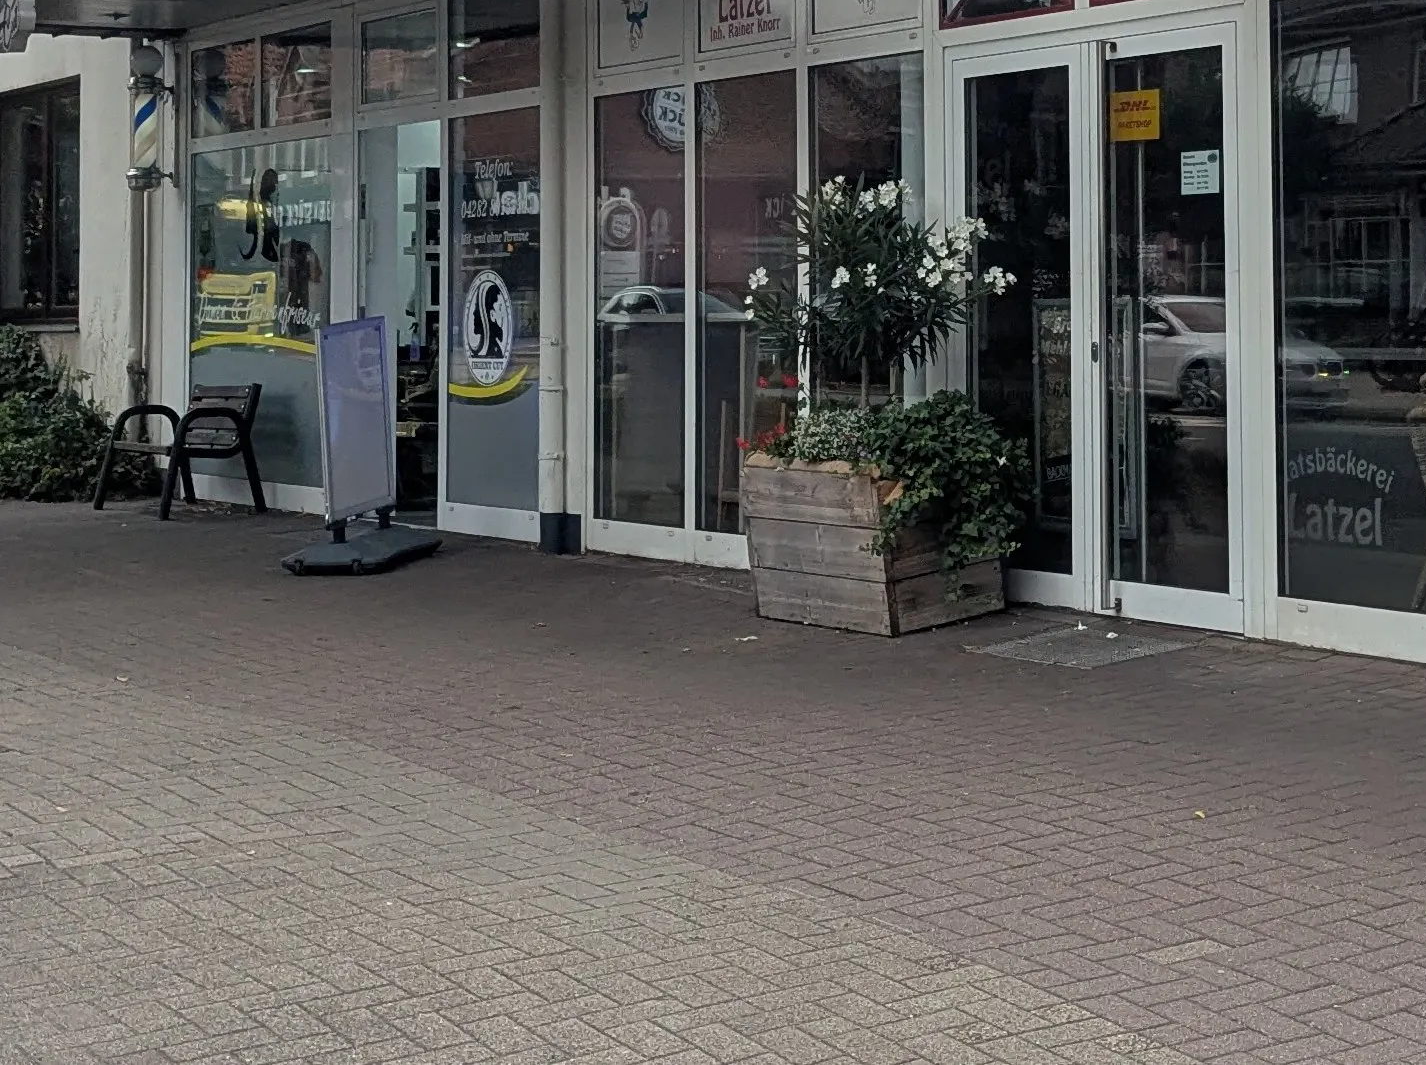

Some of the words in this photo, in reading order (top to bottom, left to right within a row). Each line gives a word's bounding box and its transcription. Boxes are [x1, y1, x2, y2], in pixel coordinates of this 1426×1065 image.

[710, 26, 726, 42] Inh.
[728, 22, 755, 38] Rainer
[757, 18, 781, 33] Knorr
[1115, 99, 1155, 113] DHL
[474, 159, 514, 180] Telefon:
[461, 198, 488, 219] 04282
[1287, 446, 1396, 494] atsbäckerei
[1287, 491, 1384, 547] Latzel
